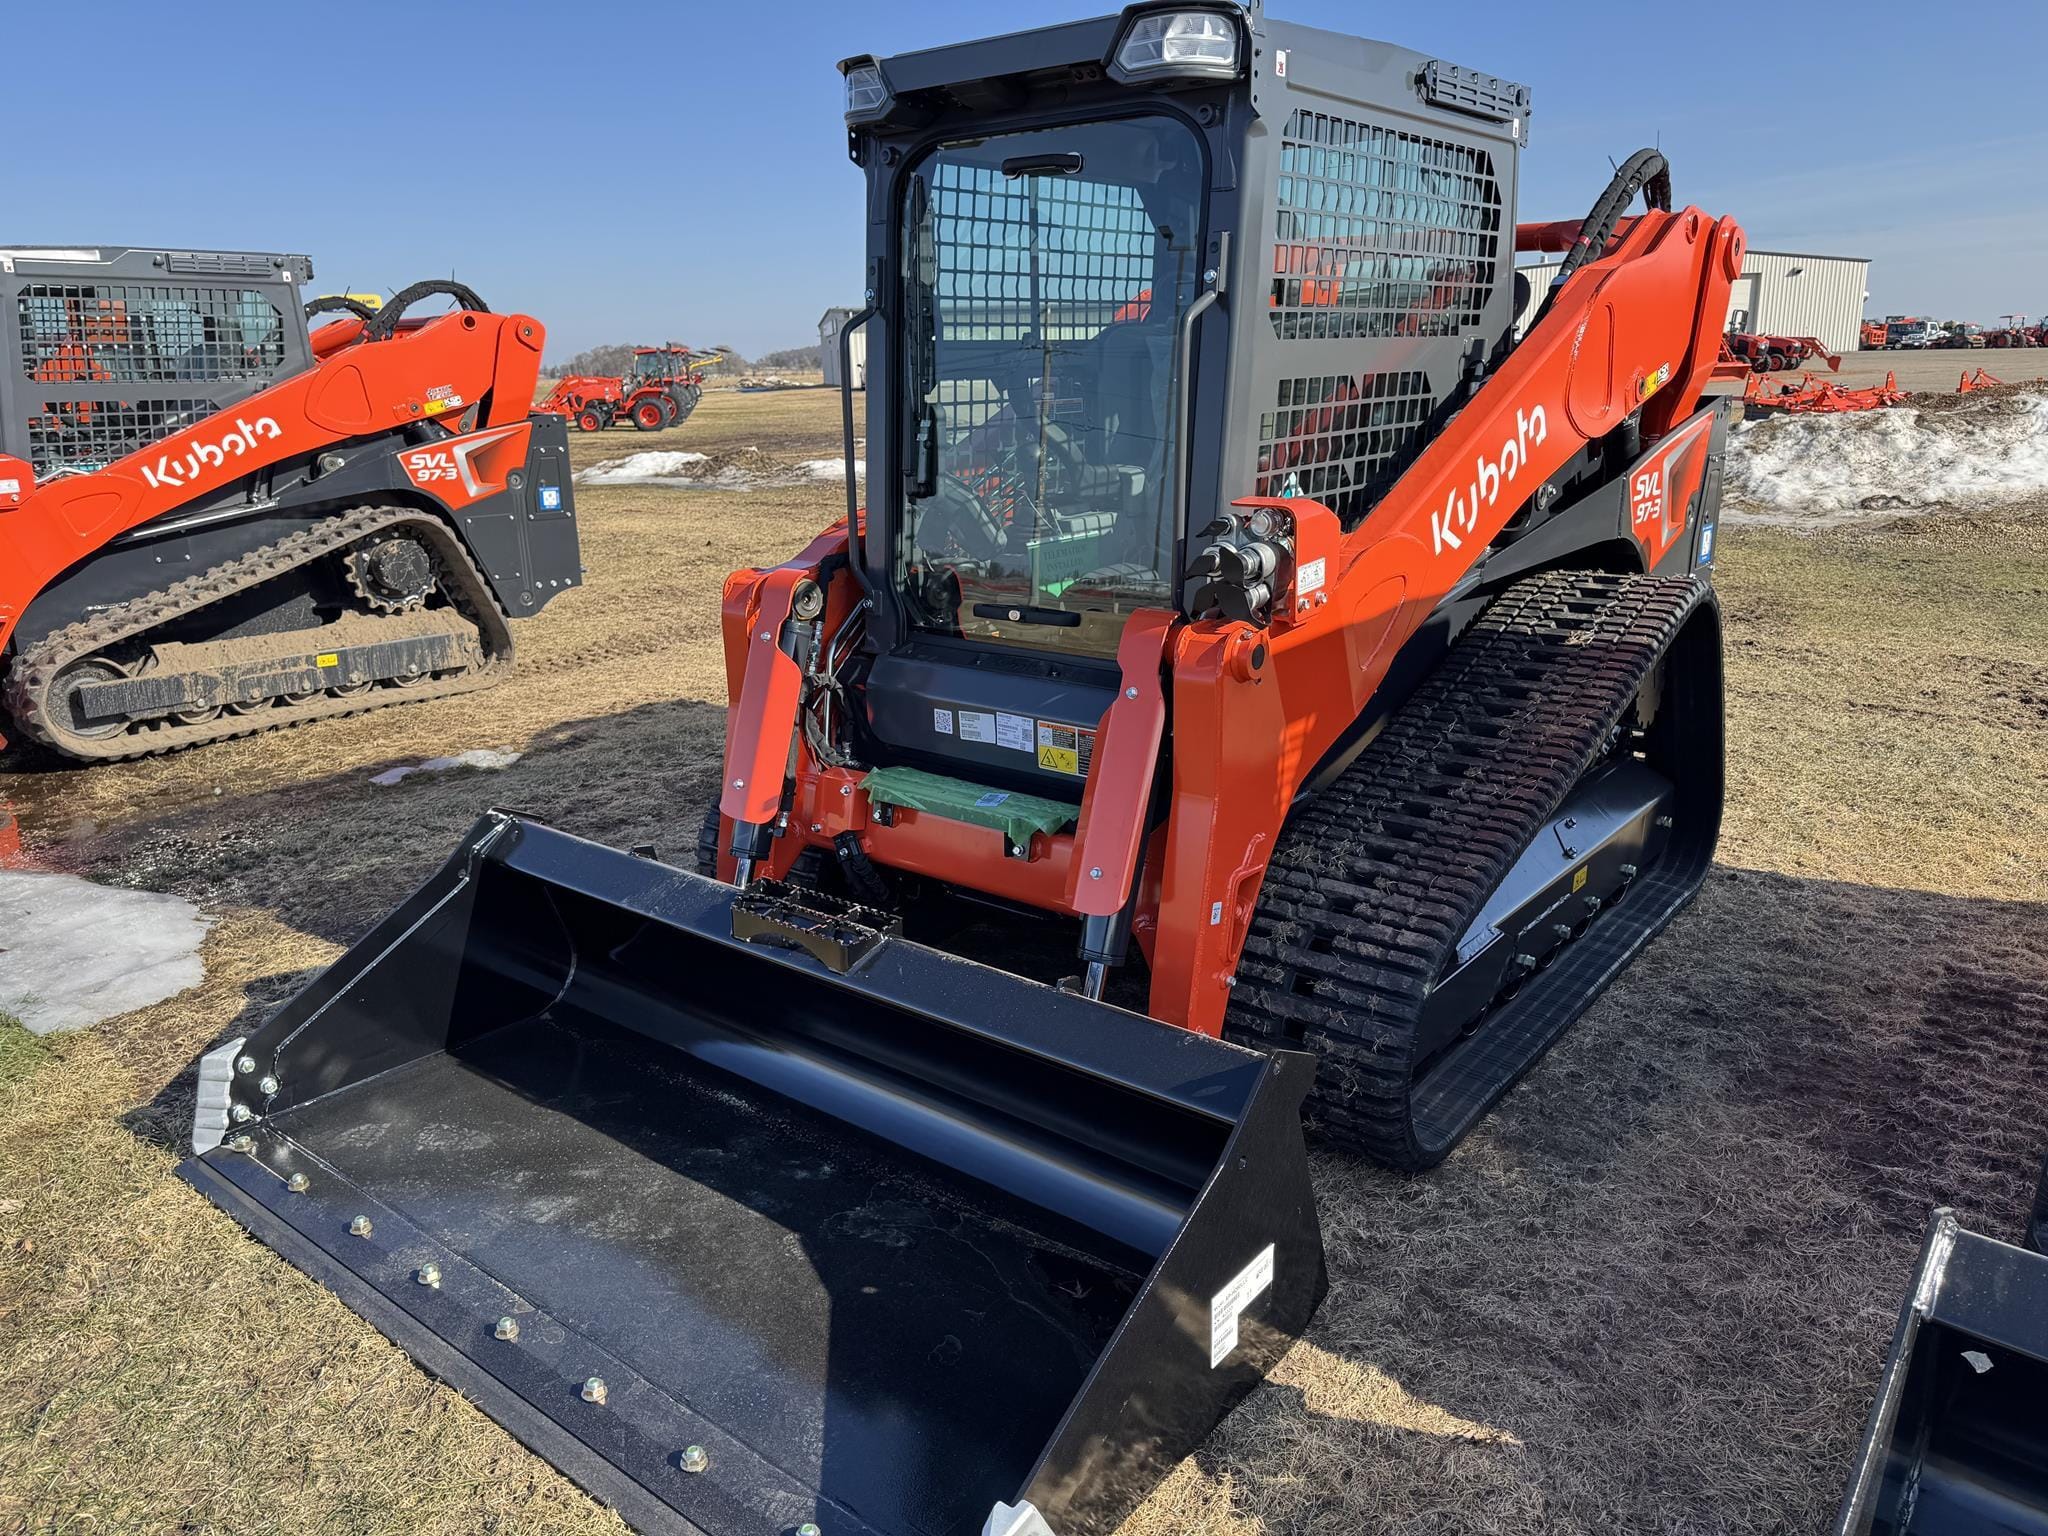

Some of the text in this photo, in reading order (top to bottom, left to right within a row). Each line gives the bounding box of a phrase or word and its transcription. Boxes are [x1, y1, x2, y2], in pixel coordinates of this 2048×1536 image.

[140, 417, 283, 489] Kubota
[408, 453, 455, 470] SVL
[416, 468, 458, 482] 97-3
[1430, 404, 1547, 557] Kubota
[1633, 471, 1662, 502] SVL
[1635, 498, 1662, 524] 97-3
